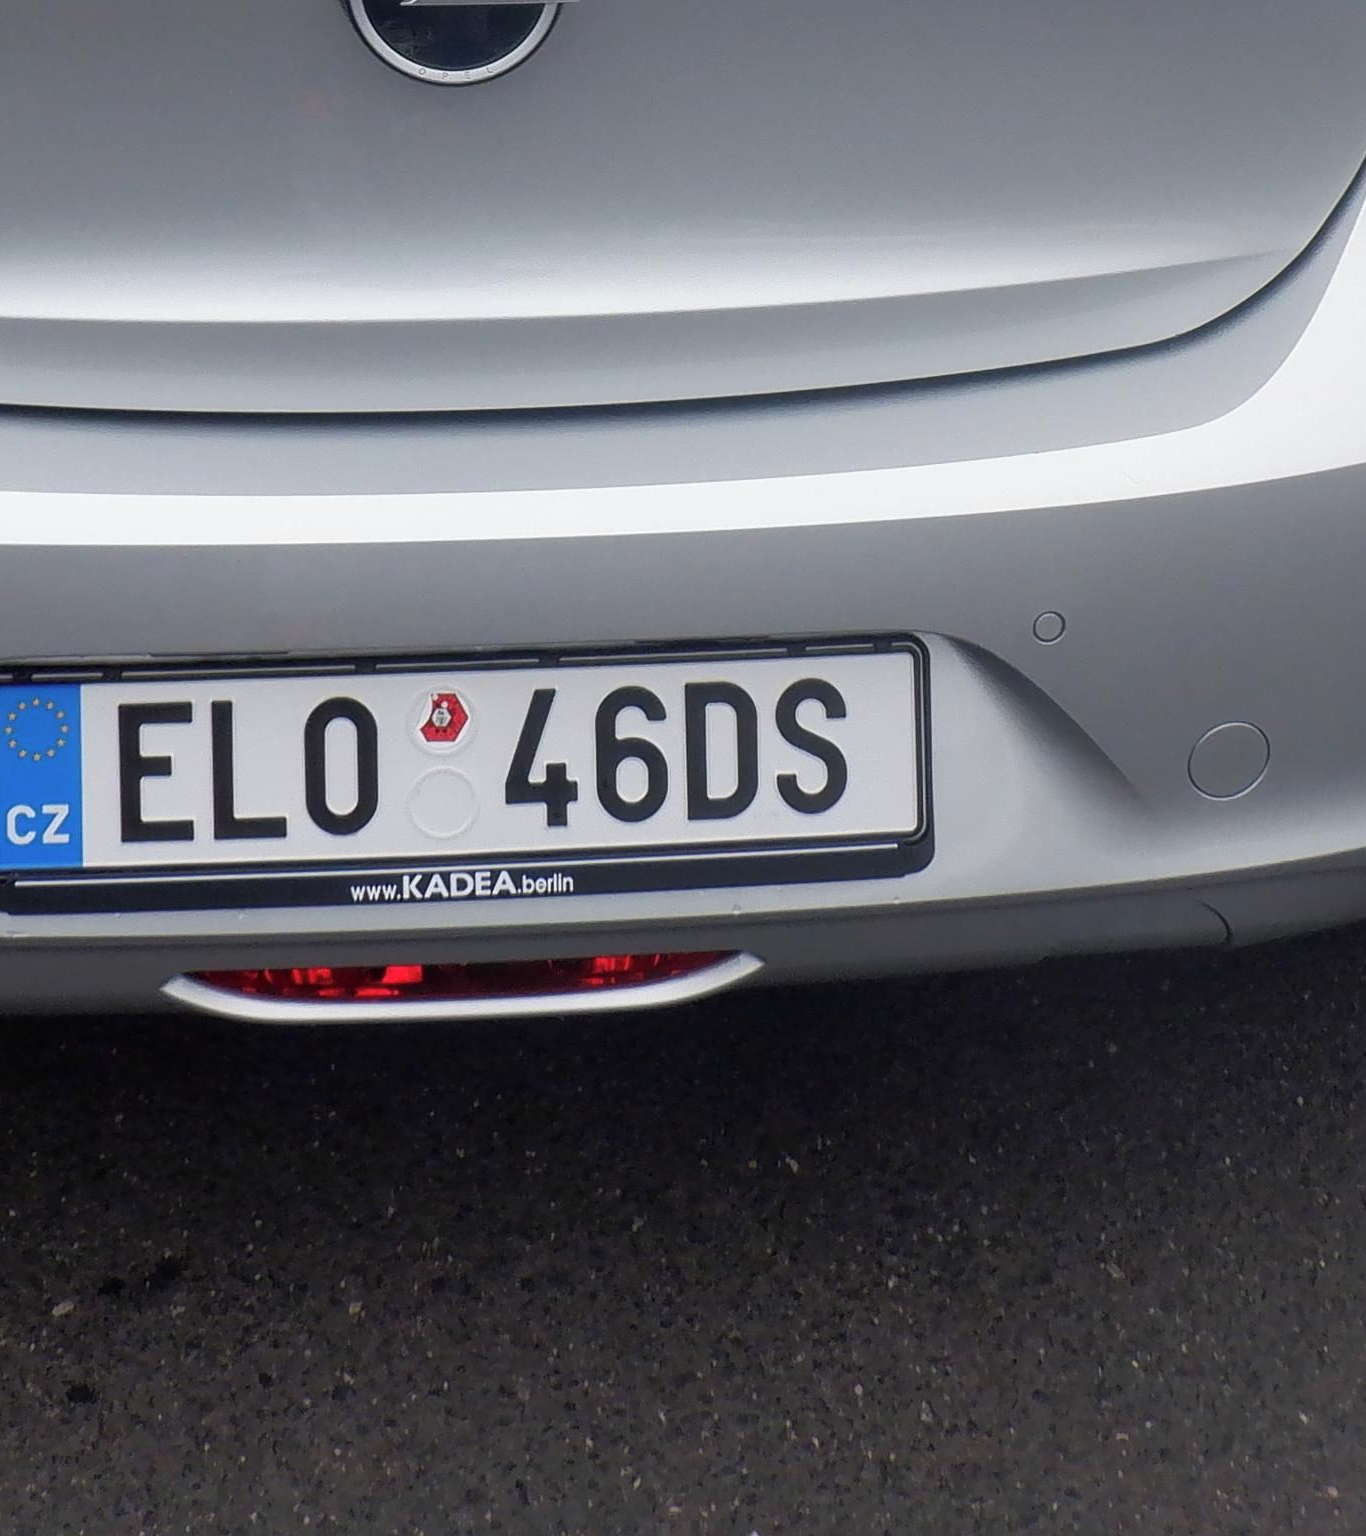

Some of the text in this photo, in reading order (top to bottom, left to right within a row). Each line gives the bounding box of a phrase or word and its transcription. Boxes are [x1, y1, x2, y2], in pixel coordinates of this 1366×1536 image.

[418, 67, 494, 81] OPEL
[504, 677, 848, 827] 46DS
[5, 803, 71, 845] CZ
[350, 870, 574, 903] www.KADEA.berlin
